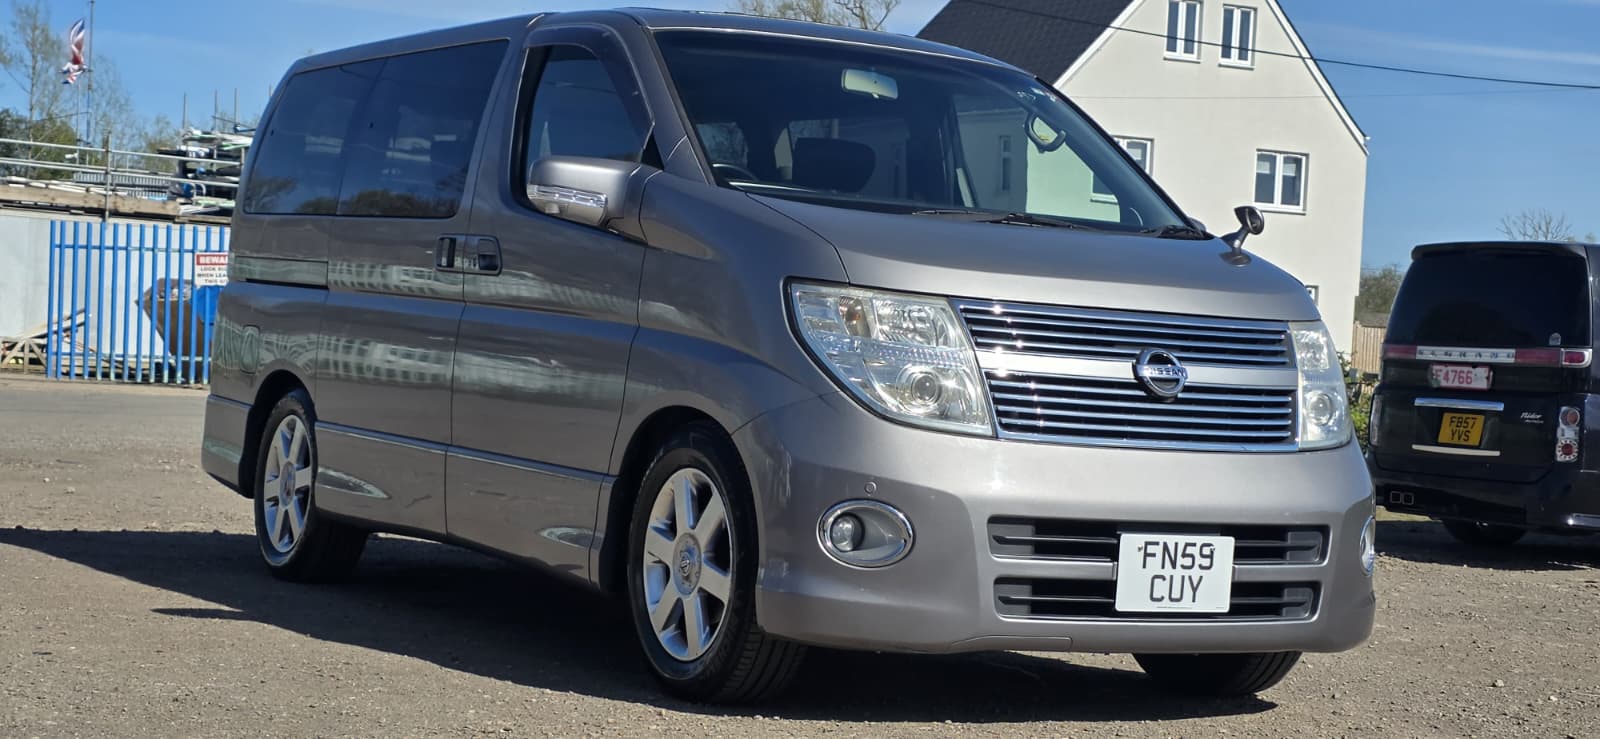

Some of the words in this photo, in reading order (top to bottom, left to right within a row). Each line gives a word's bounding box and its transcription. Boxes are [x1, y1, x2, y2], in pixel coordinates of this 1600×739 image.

[1449, 415, 1477, 429] FB57
[1450, 429, 1471, 442] YVS
[1142, 541, 1215, 570] FN59
[1149, 574, 1203, 603] CUY
